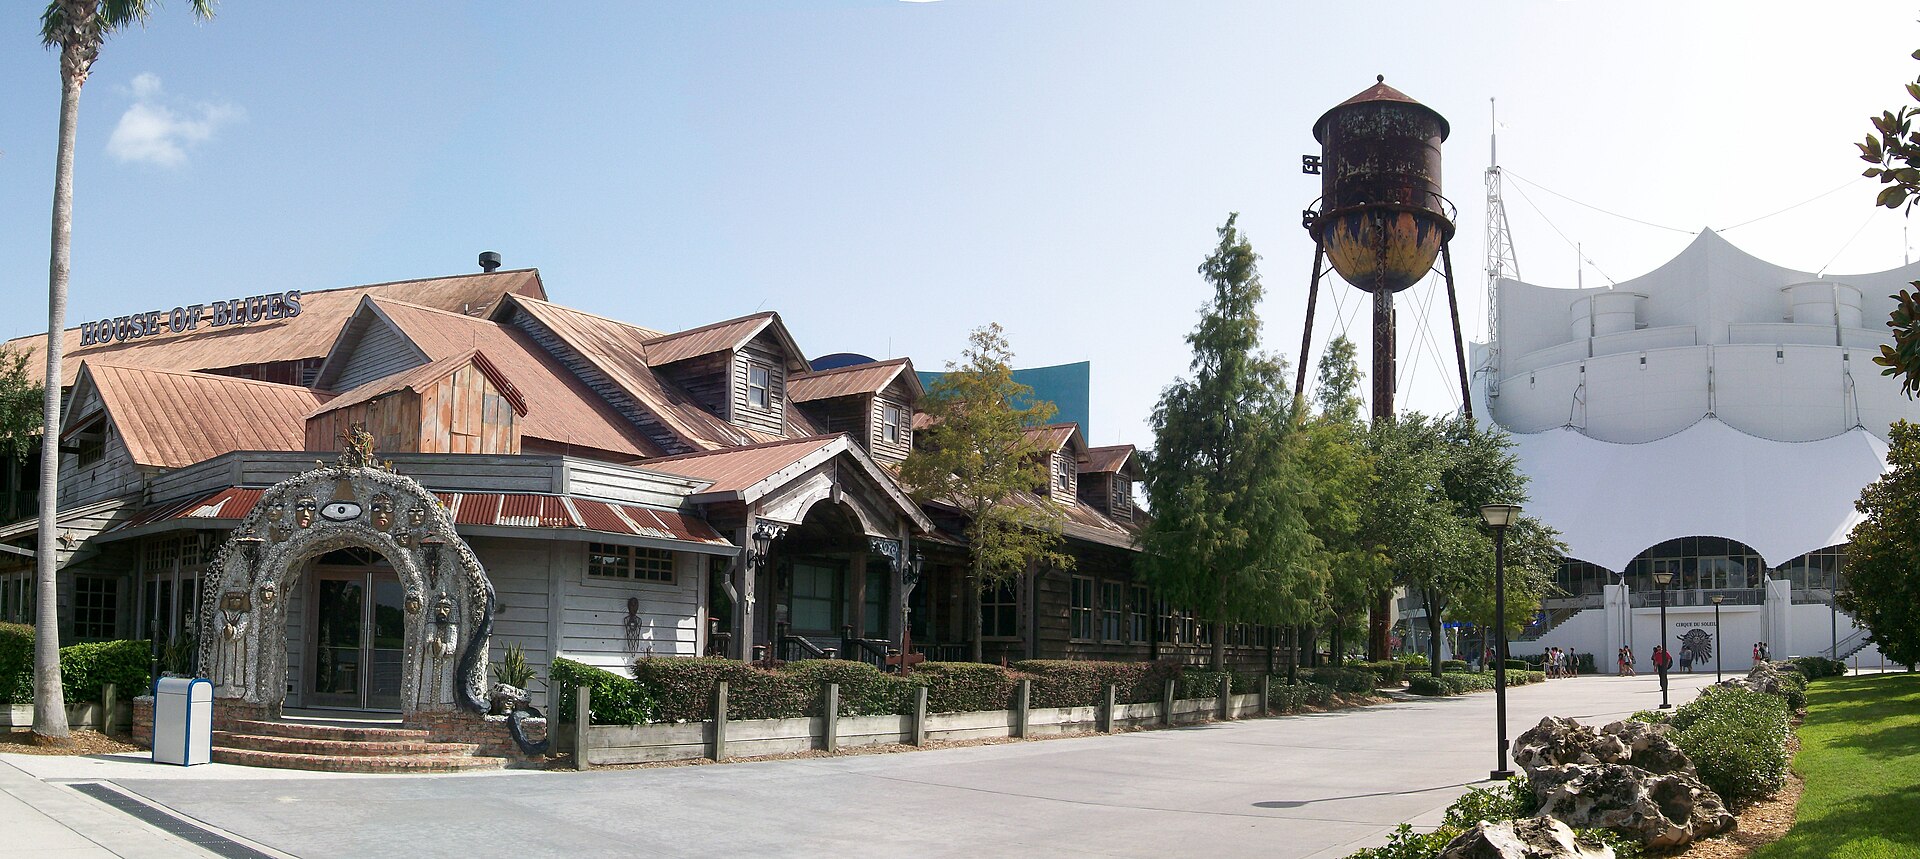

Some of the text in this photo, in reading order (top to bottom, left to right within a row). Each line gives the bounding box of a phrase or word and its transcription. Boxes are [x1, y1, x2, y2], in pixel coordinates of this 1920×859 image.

[80, 290, 301, 346] HOUSE OF BLUES
